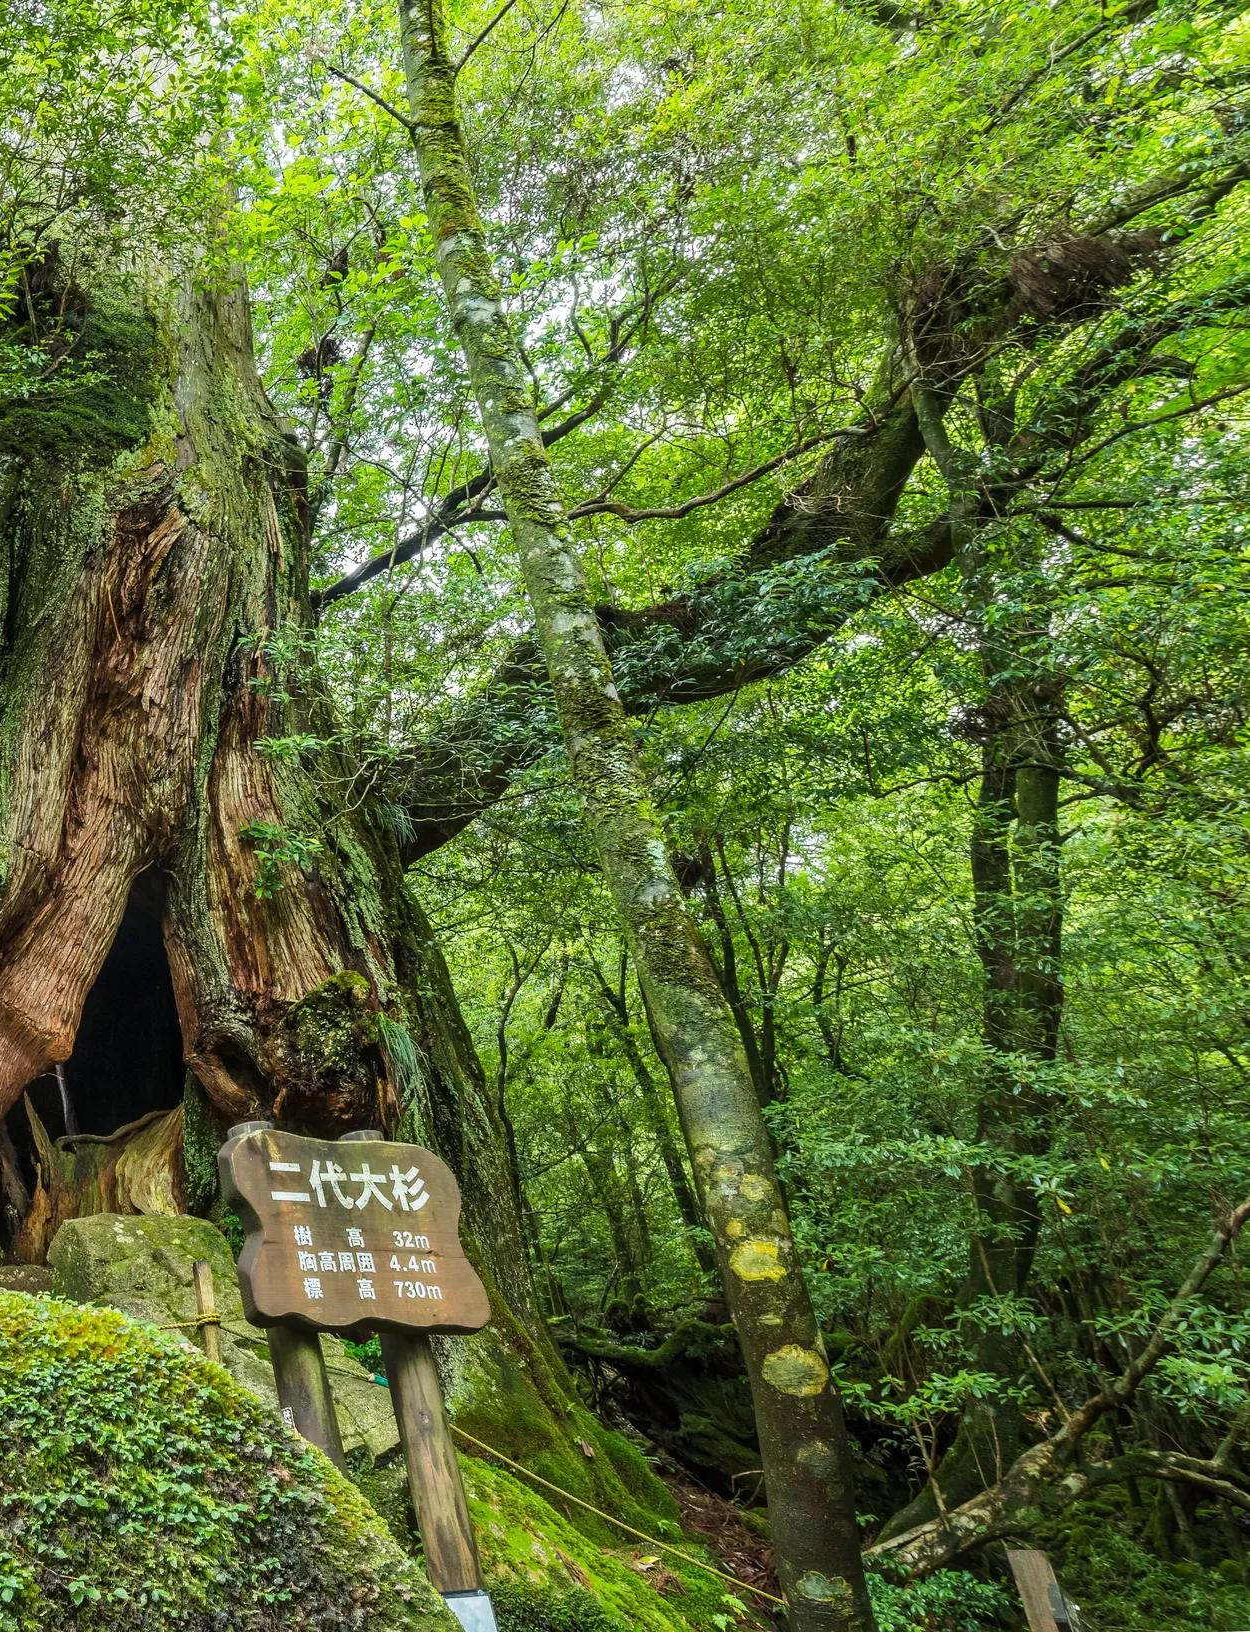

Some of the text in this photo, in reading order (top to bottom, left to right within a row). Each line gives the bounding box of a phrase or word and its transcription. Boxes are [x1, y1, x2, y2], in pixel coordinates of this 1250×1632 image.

[269, 1159, 430, 1211] 二代大杉
[393, 1231, 430, 1249] 32m
[298, 1251, 437, 1274] 胸高周囲 4.4m
[393, 1280, 443, 1300] 730m
